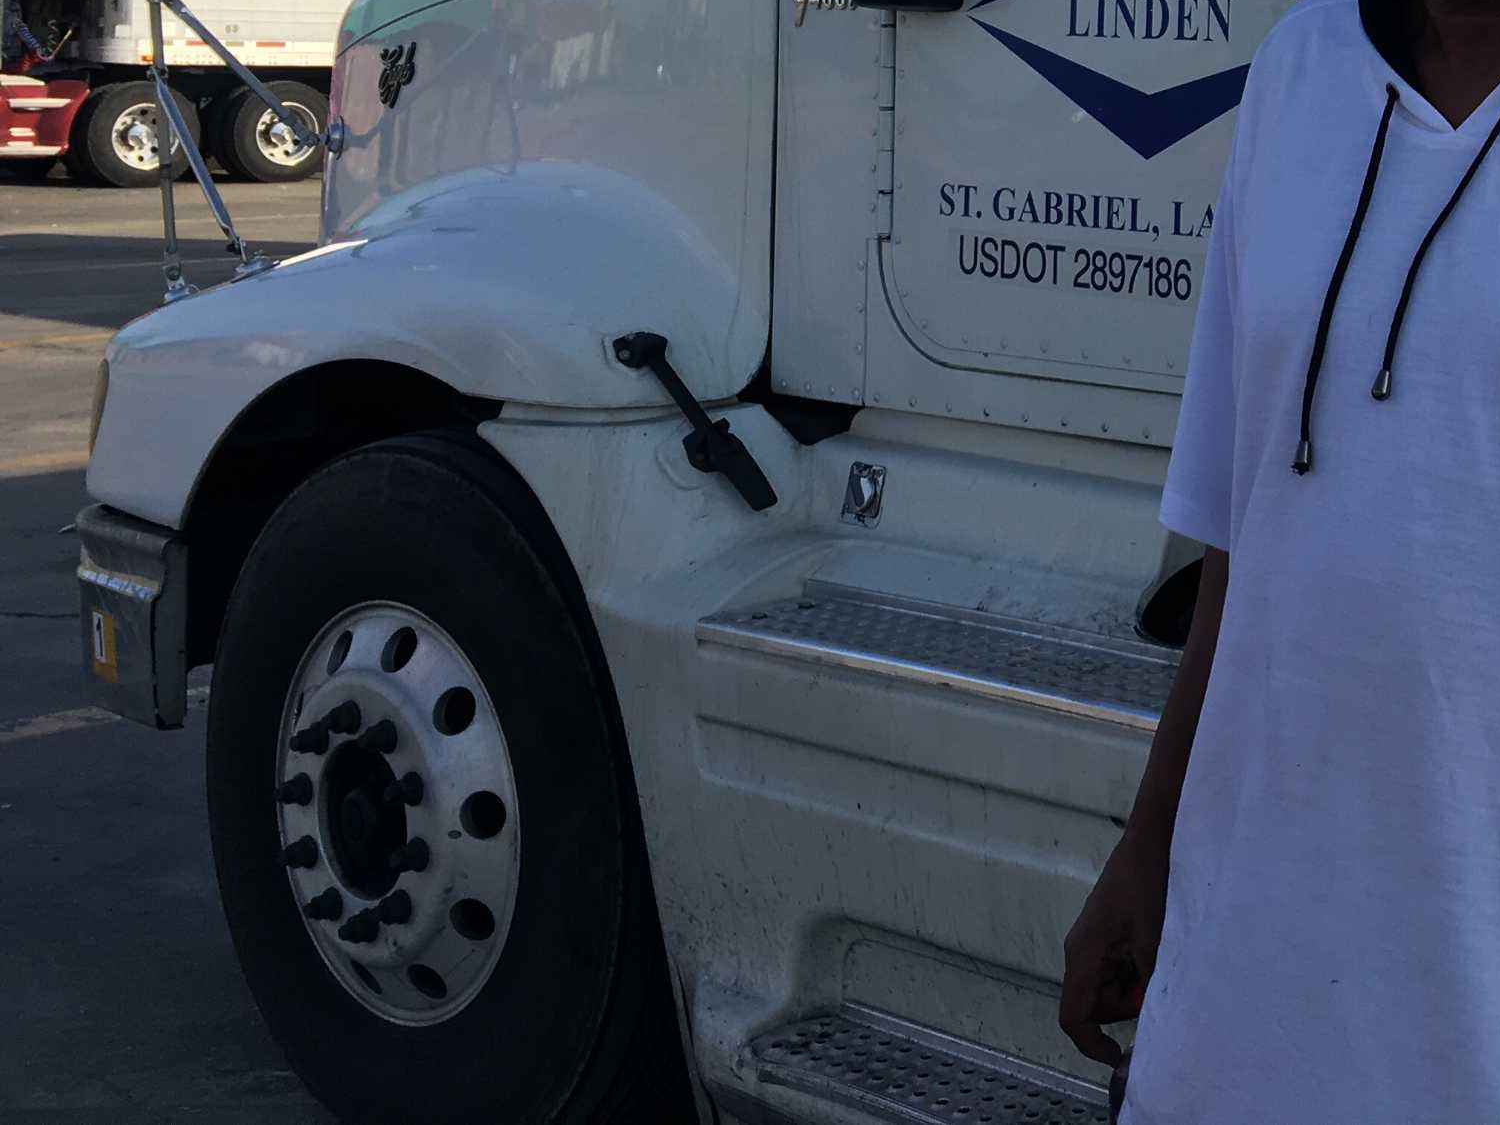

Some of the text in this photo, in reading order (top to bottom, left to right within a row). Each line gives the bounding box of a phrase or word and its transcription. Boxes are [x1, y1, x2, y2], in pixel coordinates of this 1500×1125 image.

[939, 182, 982, 219] ST.
[993, 187, 1160, 242] GABRIEL,
[959, 234, 1192, 301] USDOT 2897186
